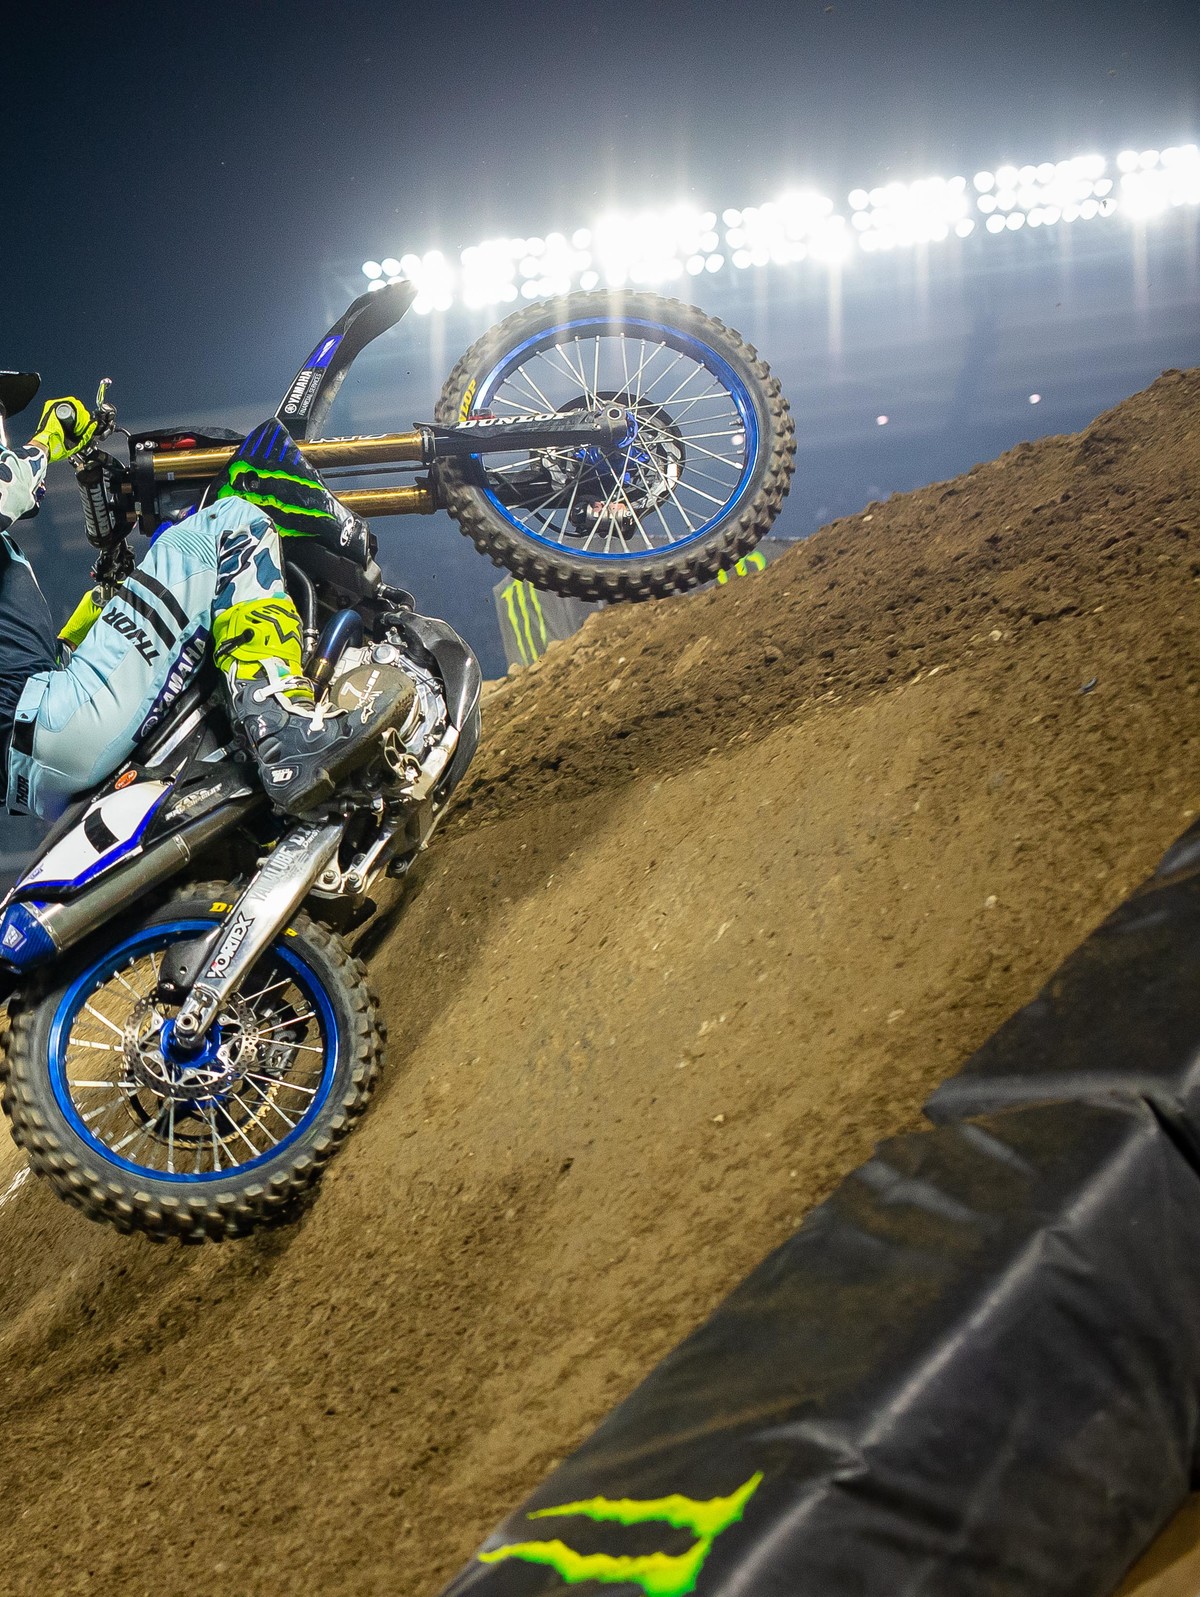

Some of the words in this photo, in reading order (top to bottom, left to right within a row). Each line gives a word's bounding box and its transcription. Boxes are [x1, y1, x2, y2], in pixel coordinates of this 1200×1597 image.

[288, 370, 313, 404] YAMAHA
[299, 393, 314, 416] FINANCIAL
[309, 372, 322, 394] SERVICES
[456, 412, 575, 429] DUNLOP
[102, 606, 160, 667] THOR
[153, 638, 206, 713] YAMAHA
[16, 774, 30, 807] THOR
[249, 844, 297, 902] YAMALUBE
[205, 911, 256, 979] VORTEX
